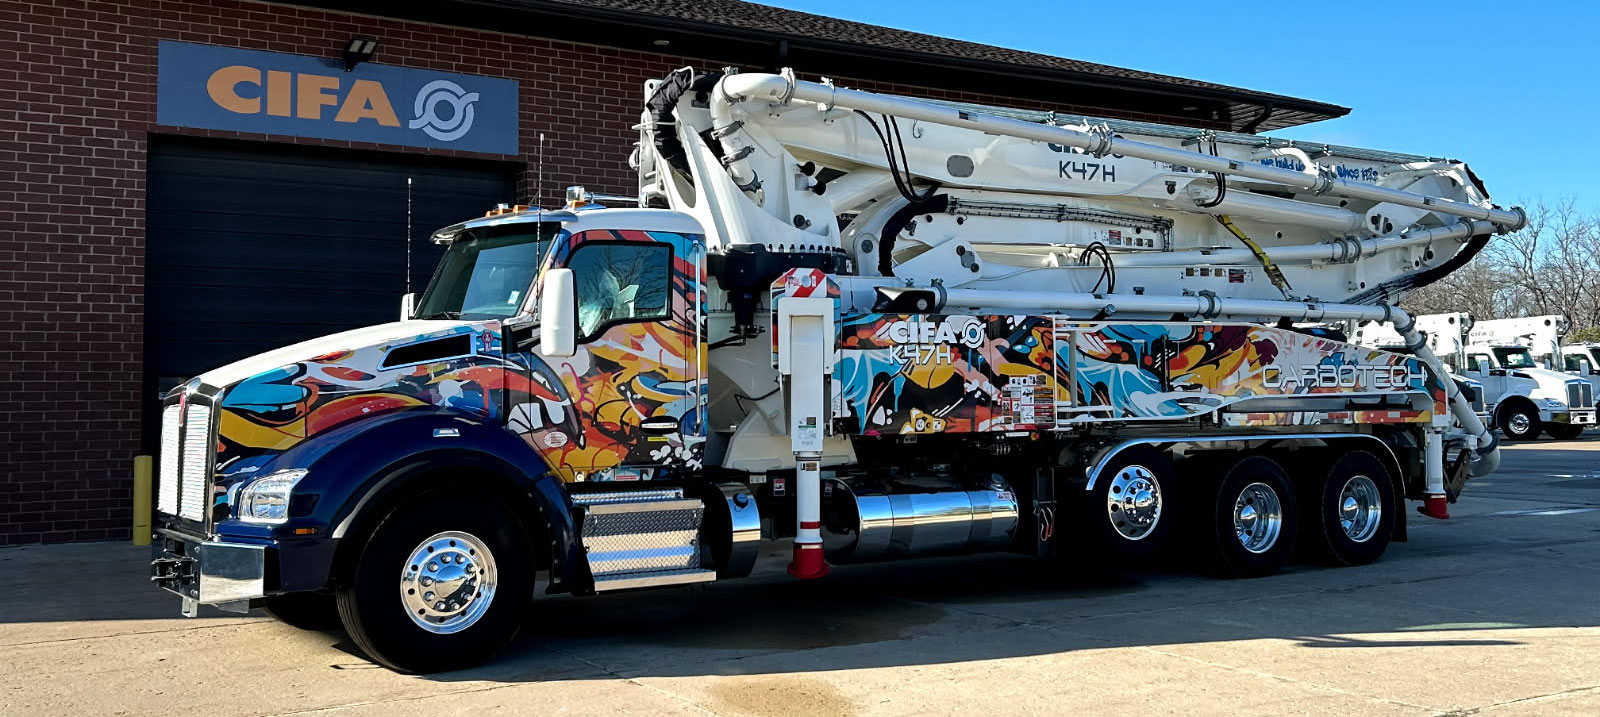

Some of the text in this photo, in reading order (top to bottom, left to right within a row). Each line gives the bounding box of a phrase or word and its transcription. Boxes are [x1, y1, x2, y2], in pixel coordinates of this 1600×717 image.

[207, 66, 400, 127] CIFA
[1059, 160, 1115, 182] K47H
[890, 321, 957, 344] CIFA
[889, 345, 951, 365] K47H
[1263, 364, 1426, 388] CARBOTECH
